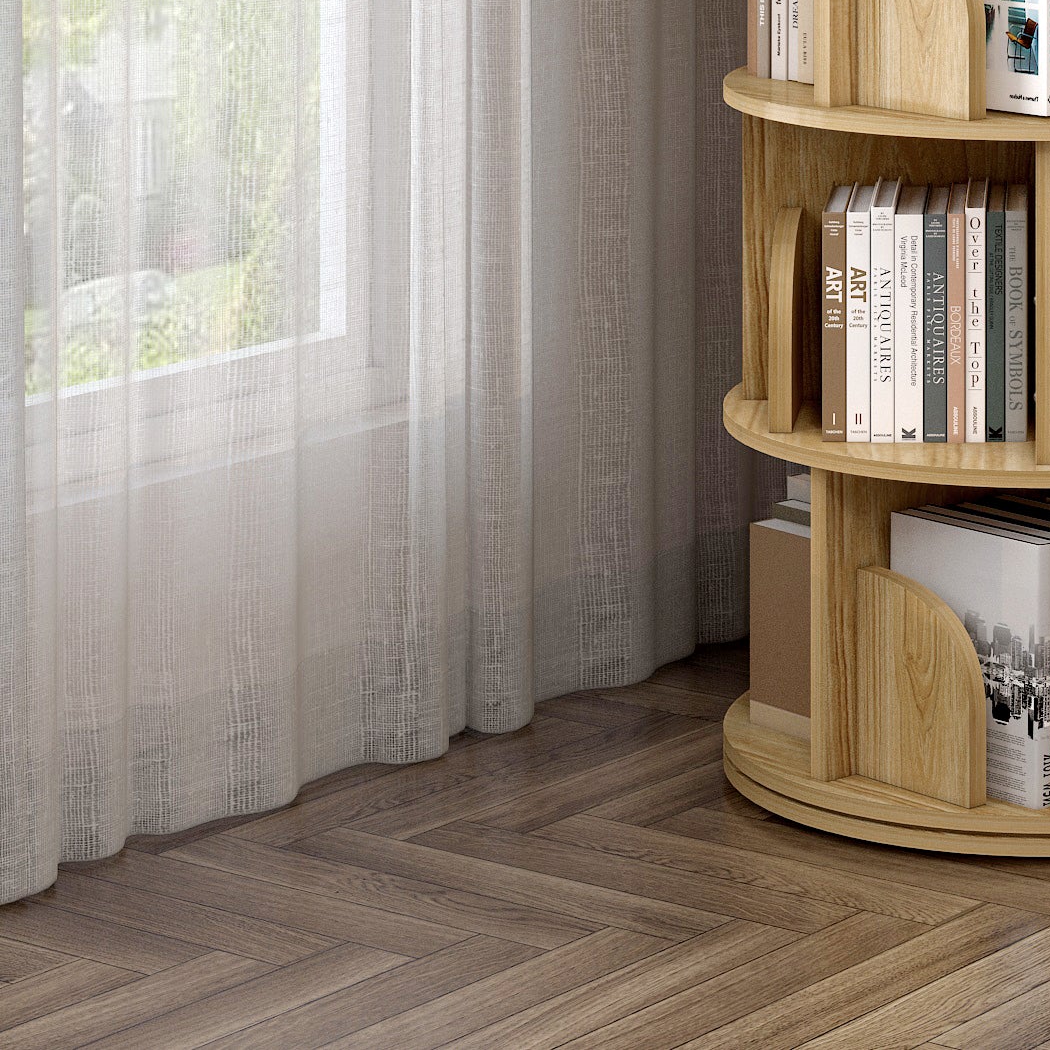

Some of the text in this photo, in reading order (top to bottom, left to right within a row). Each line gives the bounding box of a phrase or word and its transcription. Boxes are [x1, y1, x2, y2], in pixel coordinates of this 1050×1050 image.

[899, 235, 908, 288] Virginia McLeod
[909, 235, 918, 255] Detail
[994, 224, 1003, 296] TEXTILE DESIGNERS
[826, 266, 843, 303] ART
[850, 266, 867, 303] ART
[909, 263, 918, 309] Contemporary
[970, 217, 981, 388] Over the Top
[1009, 266, 1023, 312] BOOK
[877, 267, 892, 383] ANTIQUAIRES
[909, 311, 918, 347] Residential
[930, 272, 945, 384] ANTIQUAIRES
[950, 305, 961, 365] BORDEAUX
[1010, 315, 1016, 327] OF
[909, 347, 918, 387] Architecture
[1009, 330, 1023, 411] SYMBOLS
